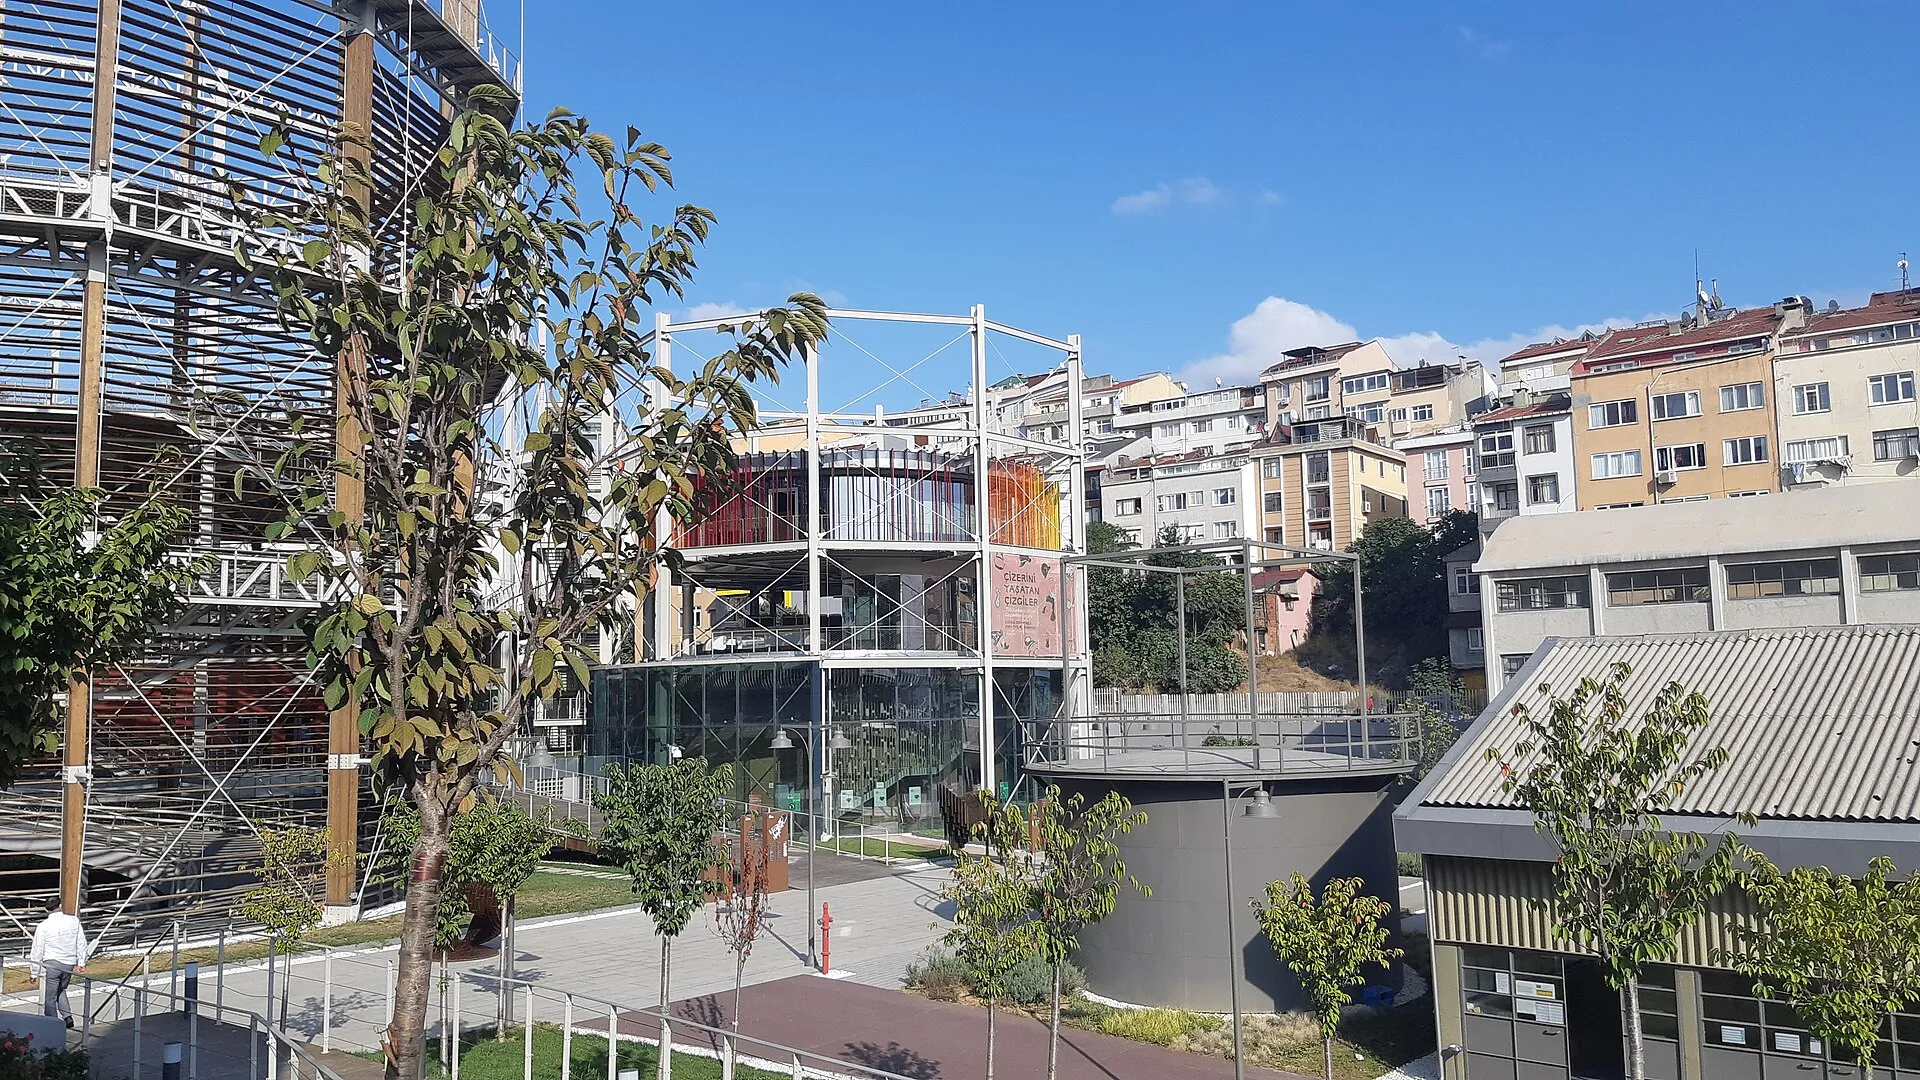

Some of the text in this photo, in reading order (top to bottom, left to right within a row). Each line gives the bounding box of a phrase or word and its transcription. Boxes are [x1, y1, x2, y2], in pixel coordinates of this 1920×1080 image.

[1003, 570, 1036, 583] ÇİZERİNİ
[1004, 584, 1040, 595] YAŞATAN
[1004, 595, 1038, 606] ÇİZGİLER
